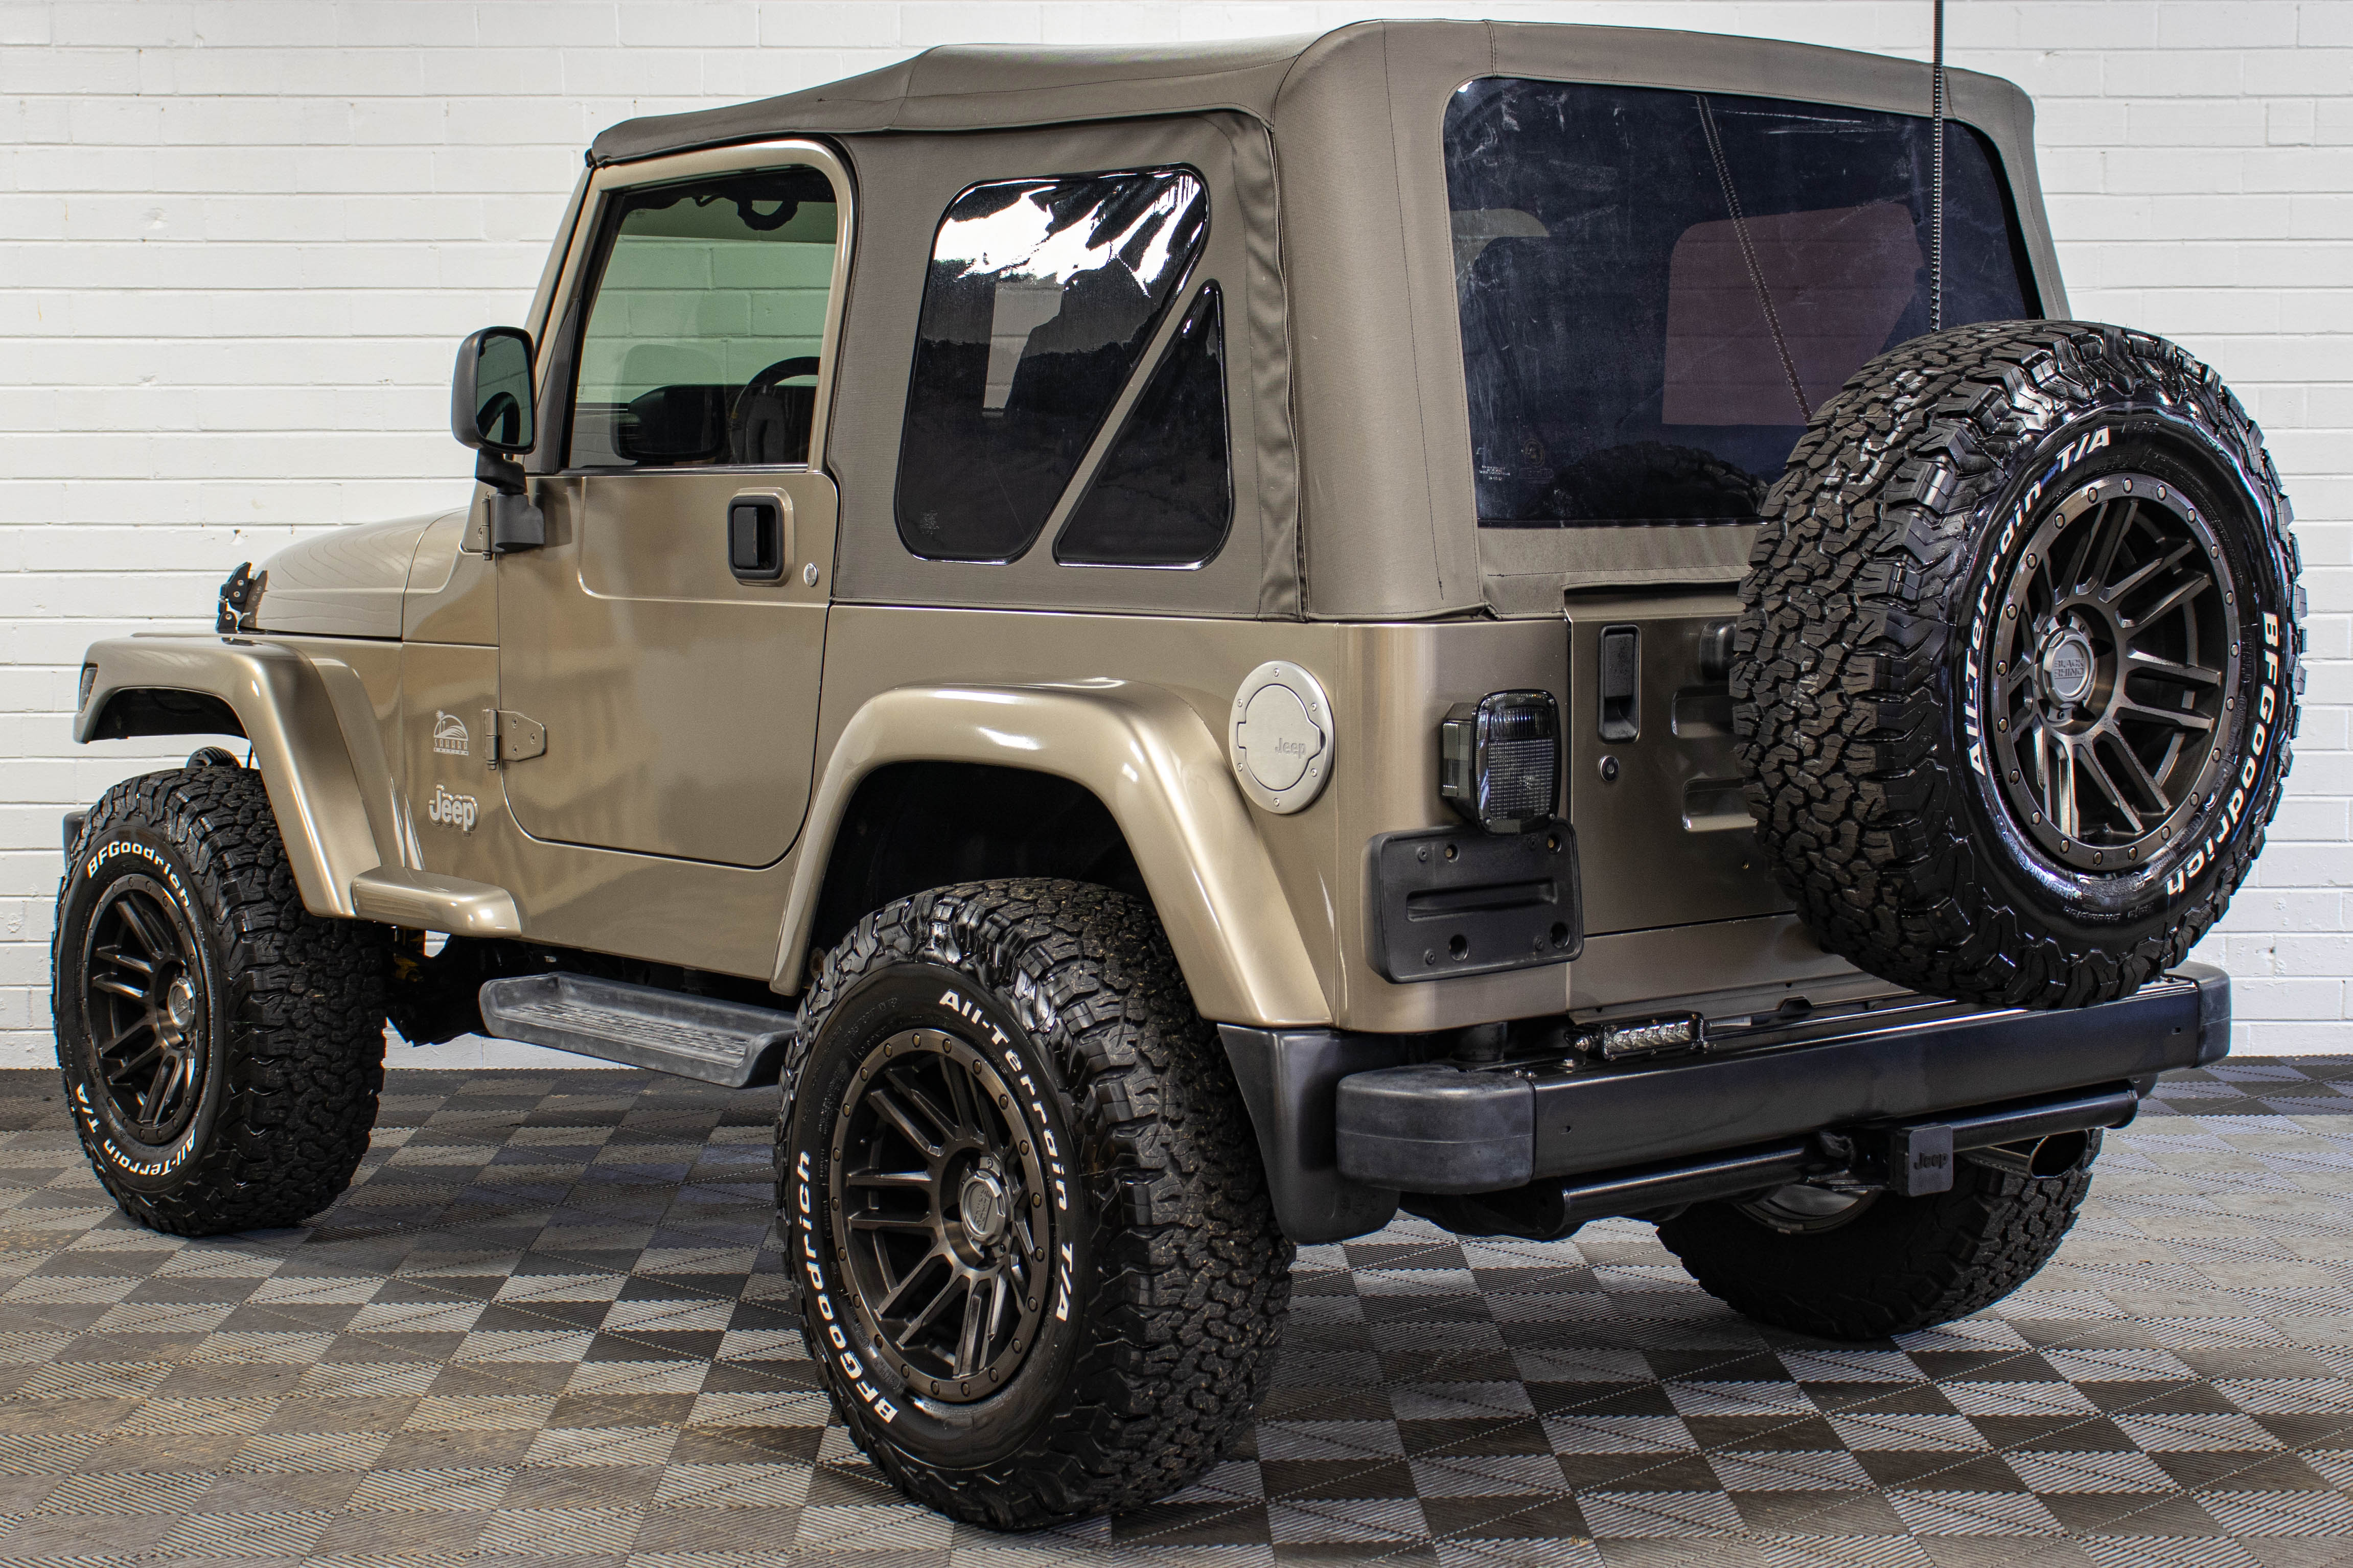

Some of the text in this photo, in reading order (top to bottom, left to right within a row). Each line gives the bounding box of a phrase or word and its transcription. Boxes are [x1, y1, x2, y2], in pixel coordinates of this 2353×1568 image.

[1965, 426, 2110, 776] All-Terrain T/A
[2055, 659, 2084, 668] BLACK
[434, 738, 468, 750] SAHARA
[1275, 738, 1306, 759] Jeep
[2166, 612, 2279, 885] BFGoodrich
[429, 784, 478, 836] Jeep
[87, 840, 190, 907] BFGoodrich
[76, 1083, 196, 1176] All-Terrain T/A
[939, 989, 1073, 1321] All-Terrain T/A
[1913, 1152, 1948, 1170] Jeep
[797, 1150, 899, 1423] BFGoodrich
